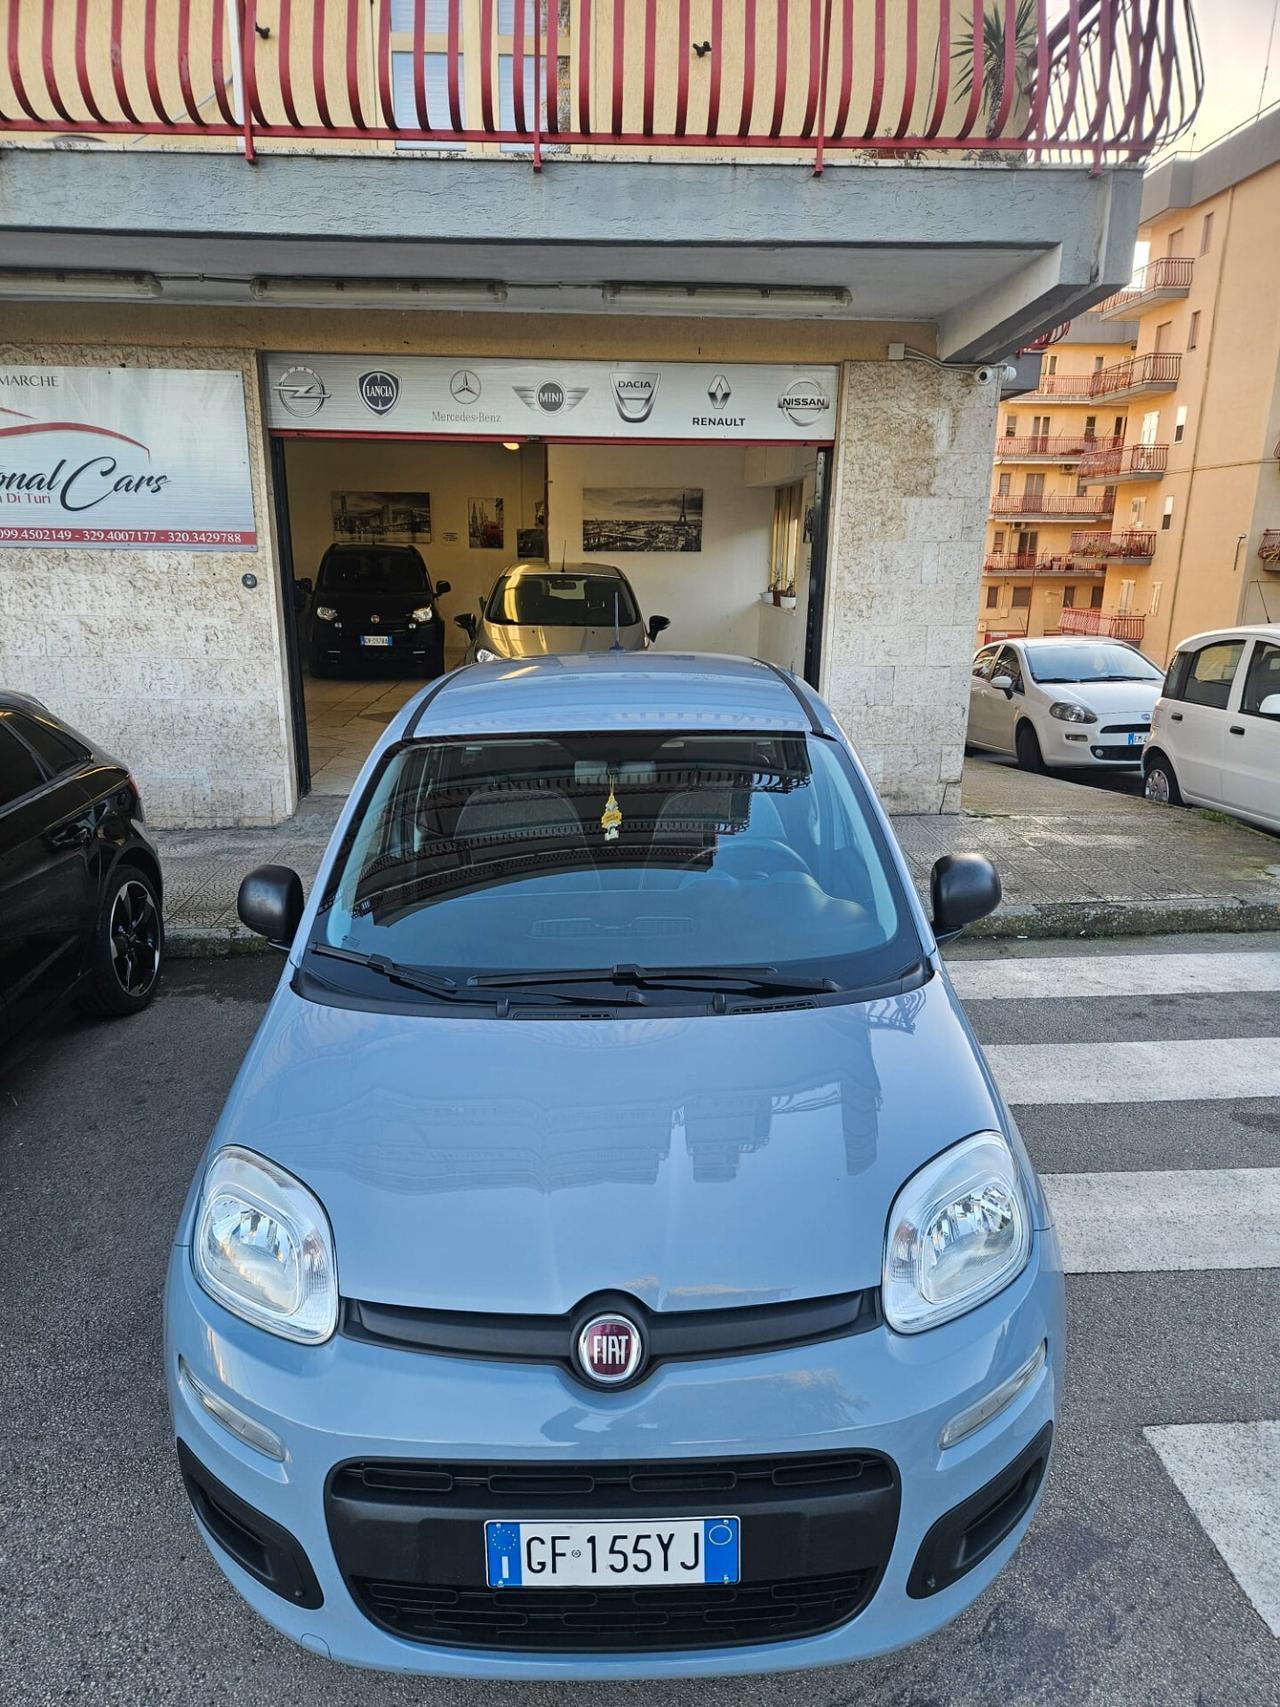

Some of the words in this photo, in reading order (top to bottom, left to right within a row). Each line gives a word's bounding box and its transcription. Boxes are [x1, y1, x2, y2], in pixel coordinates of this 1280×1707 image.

[618, 380, 651, 389] DACIA
[366, 384, 393, 398] LANCIA
[540, 393, 563, 404] MINI
[783, 397, 825, 406] NISSAN
[432, 412, 501, 422] Mercedes-Benz
[692, 417, 746, 427] RENAULT
[60, 456, 171, 512] Cars
[7, 493, 21, 503] Di
[25, 492, 51, 504] Turi
[82, 531, 156, 542] 329.4007177
[168, 532, 241, 543] 320.3429788
[593, 1335, 629, 1365] FIAT
[526, 1536, 571, 1574] GF
[586, 1532, 700, 1573] 155YJ
